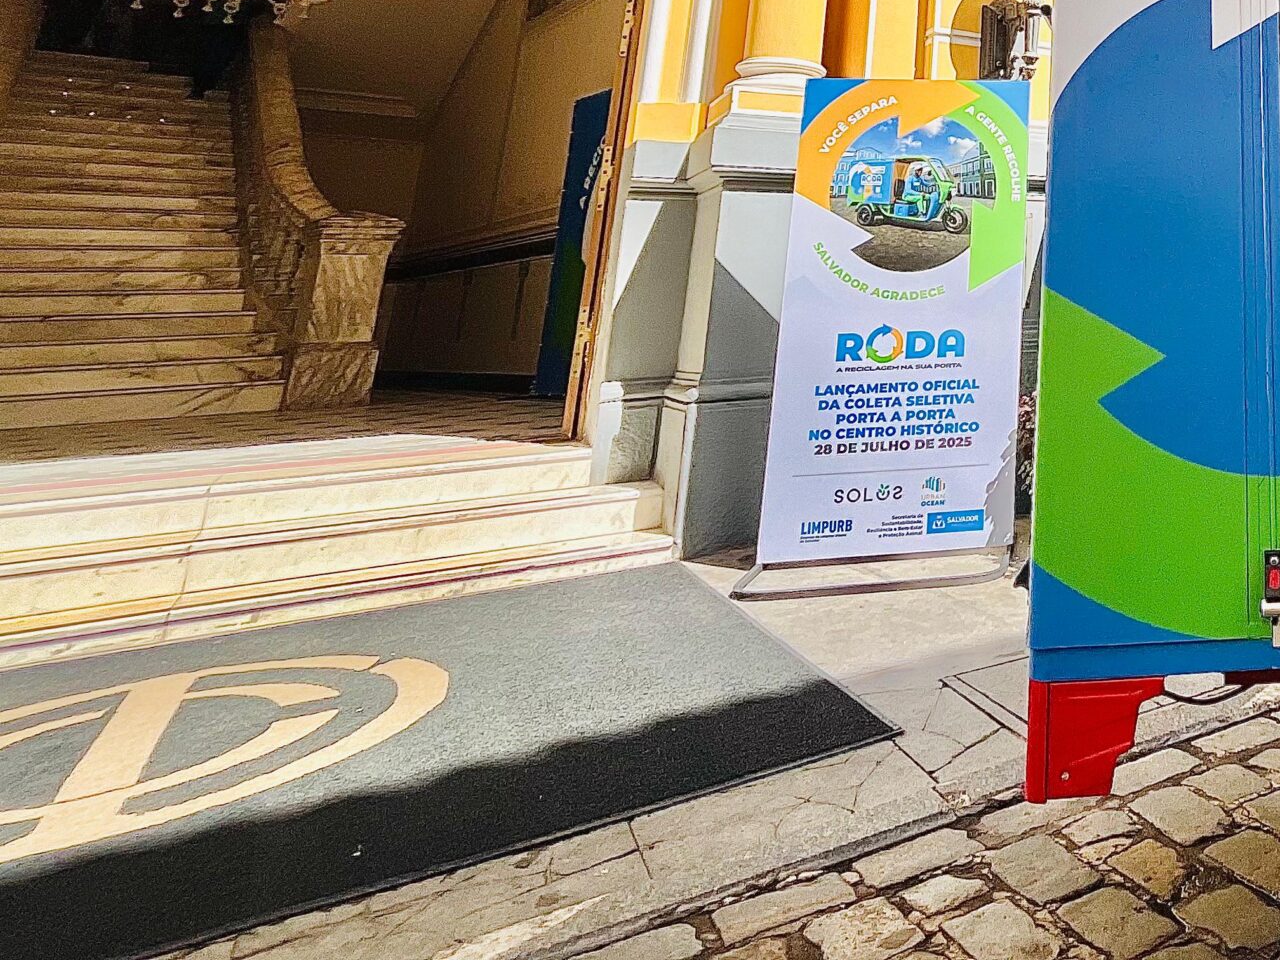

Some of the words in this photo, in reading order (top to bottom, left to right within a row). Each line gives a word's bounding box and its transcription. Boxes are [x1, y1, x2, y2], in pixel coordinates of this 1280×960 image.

[819, 120, 849, 154] VOCÊ
[847, 95, 898, 126] SEPARA
[964, 106, 976, 116] A
[975, 112, 1008, 147] GENTE
[1002, 144, 1021, 202] RECOLHE
[813, 242, 874, 294] SALVADOR
[870, 285, 945, 301] AGRADECE
[835, 324, 966, 363] RODA
[814, 381, 918, 397] LANÇAMENTO
[922, 379, 980, 392] OFICIAL
[818, 399, 840, 410] DA
[844, 397, 902, 410] COLETA
[906, 393, 975, 407] SELETIVA
[836, 412, 887, 425] PORTA
[890, 411, 902, 422] A
[906, 408, 955, 421] PORTA
[808, 429, 831, 441] NO
[835, 426, 896, 439] CENTRO
[900, 421, 980, 436] HISTÓRICO
[814, 443, 832, 455] 28
[836, 442, 857, 454] DE
[861, 439, 911, 453] JULHO
[914, 438, 935, 450] DE
[938, 436, 972, 449] 2025
[800, 520, 853, 535] LIMPURB
[946, 515, 979, 524] SALVADOR
